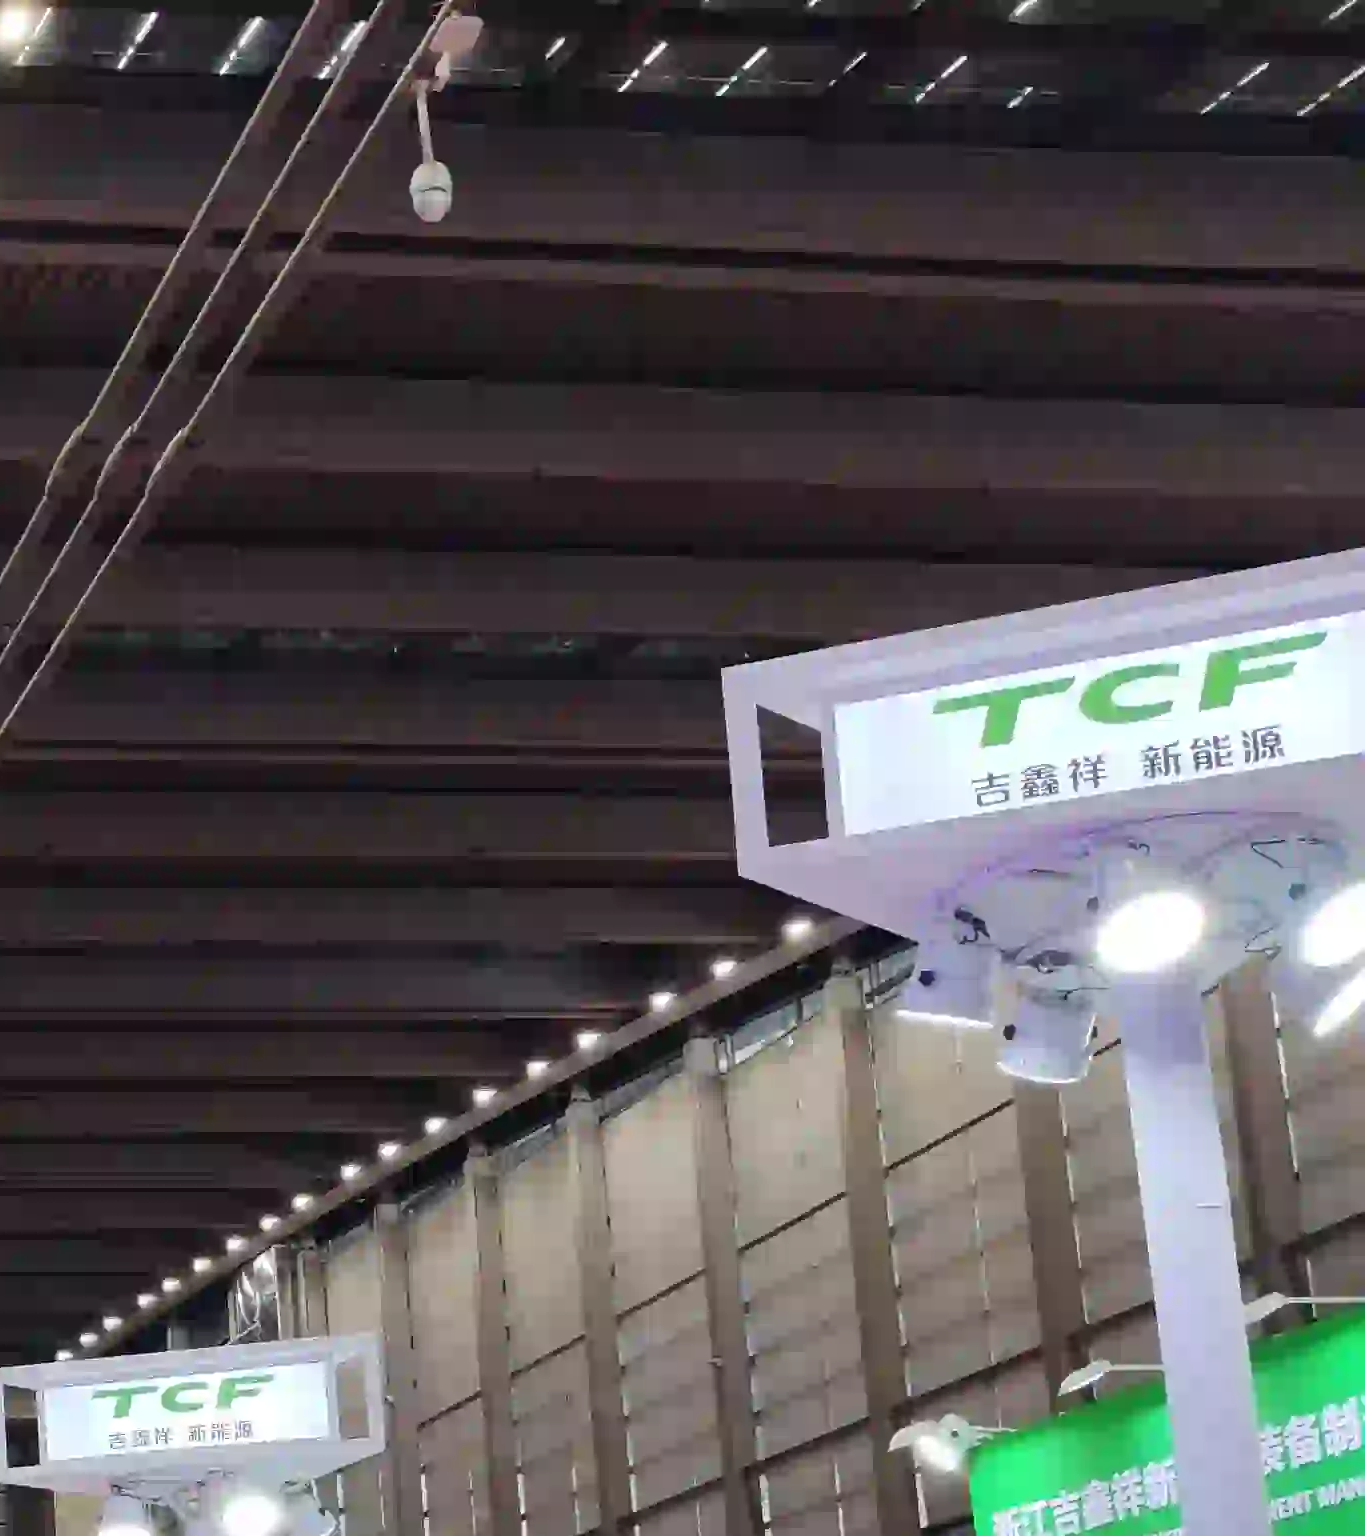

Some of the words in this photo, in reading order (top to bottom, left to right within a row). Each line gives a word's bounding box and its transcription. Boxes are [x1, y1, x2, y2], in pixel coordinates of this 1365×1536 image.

[932, 631, 1328, 748] TCF
[971, 753, 1108, 809] 吉鑫祥
[1140, 723, 1286, 779] 新能源
[91, 1374, 275, 1418] TCF
